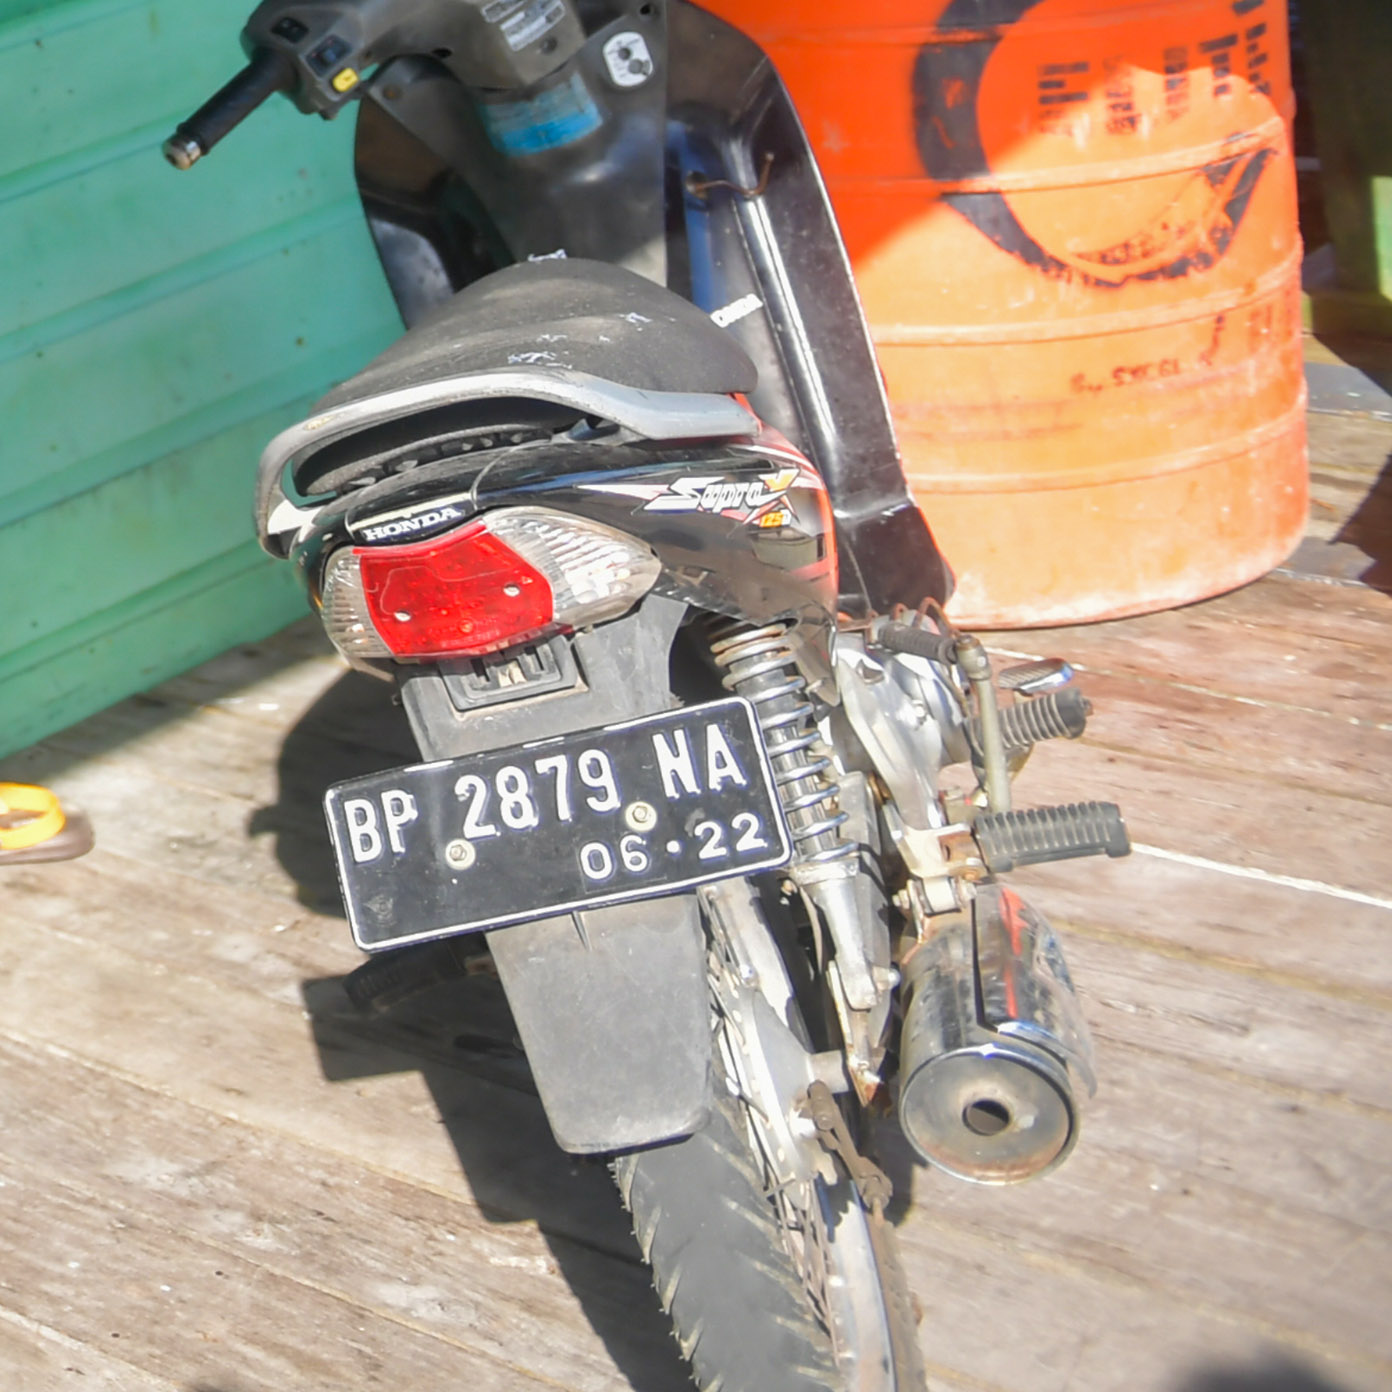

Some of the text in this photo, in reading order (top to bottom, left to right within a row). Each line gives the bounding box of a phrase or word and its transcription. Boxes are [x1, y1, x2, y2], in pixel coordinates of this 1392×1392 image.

[364, 506, 461, 542] HONDA
[343, 723, 748, 865] BP 2879 NA
